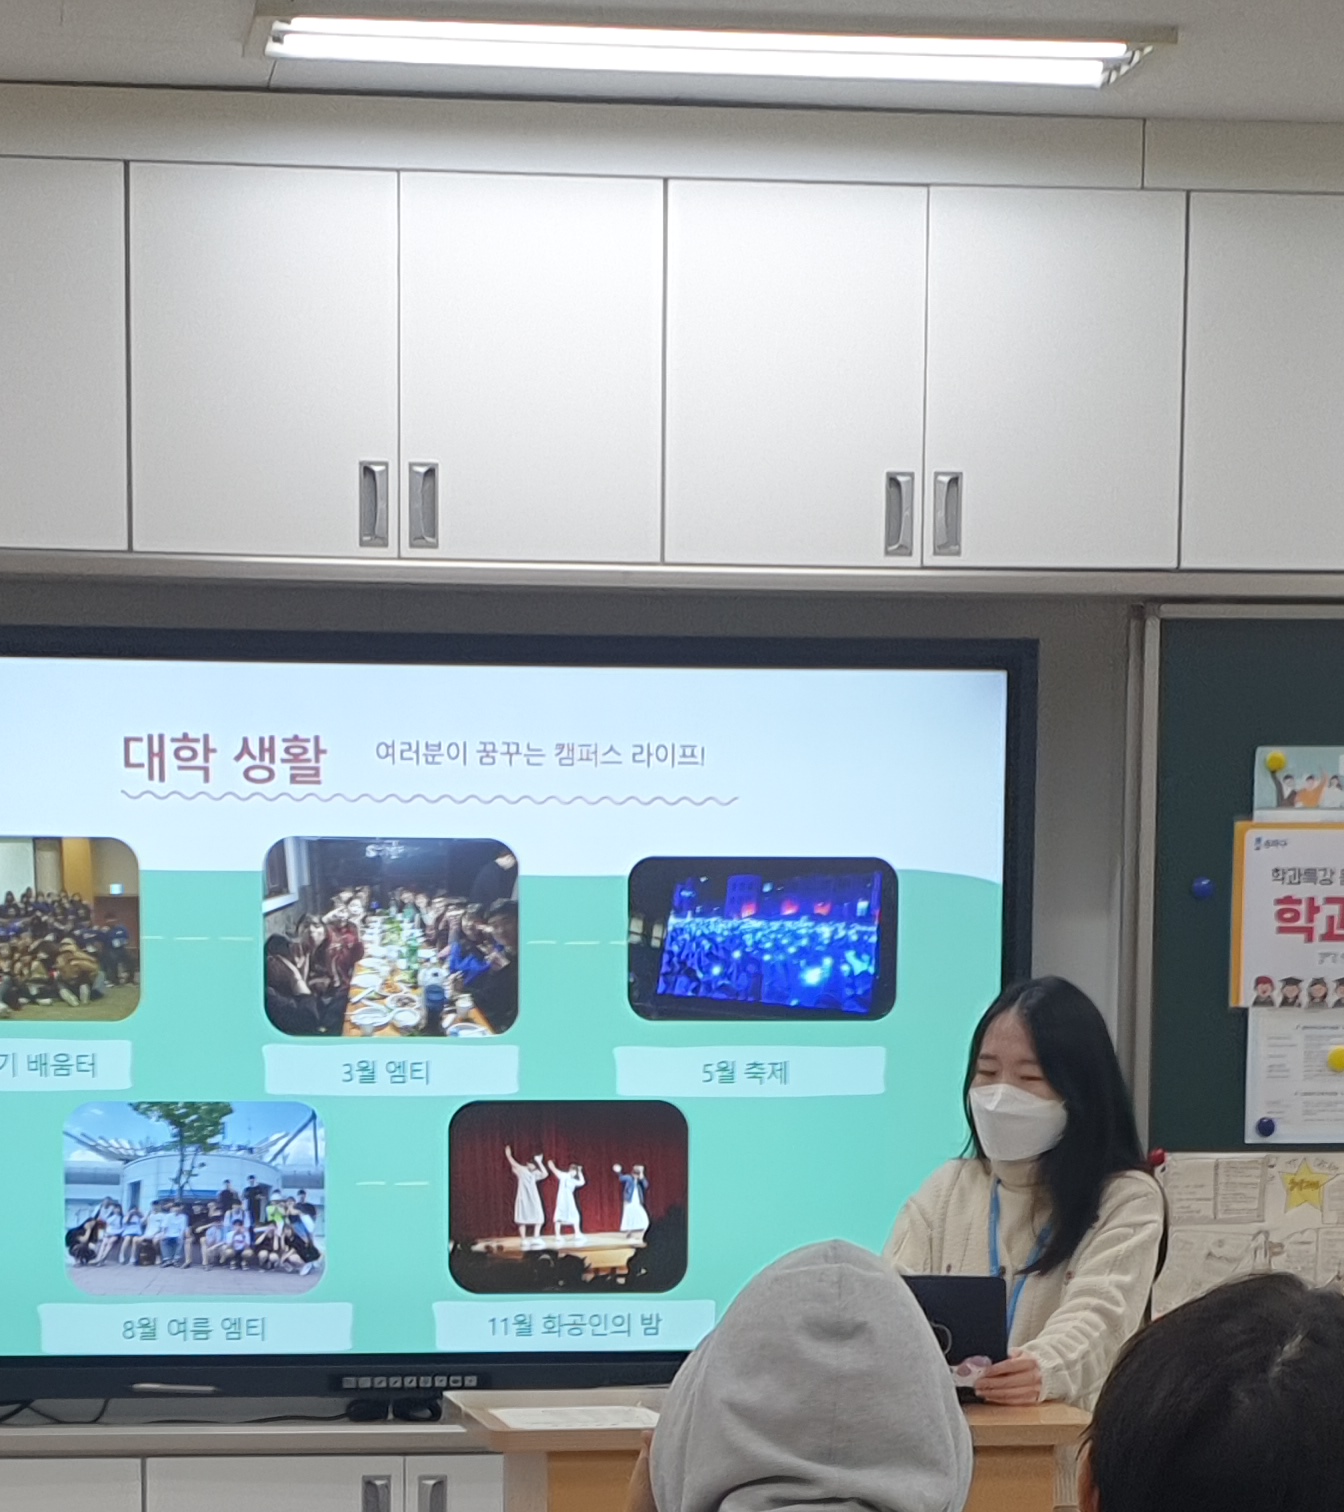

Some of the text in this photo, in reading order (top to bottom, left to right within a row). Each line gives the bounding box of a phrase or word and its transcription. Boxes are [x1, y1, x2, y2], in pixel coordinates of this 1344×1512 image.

[122, 732, 329, 786] 대학 생활
[375, 740, 707, 769] 여러분이 꿈꾸는 캠퍼스 라이프!
[1271, 866, 1335, 887] 학과특강
[26, 1051, 97, 1079] 배움터
[341, 1059, 431, 1086] 3월 엠티
[701, 1060, 790, 1087] 5월 축제
[121, 1316, 267, 1342] 8월 여름 엠티
[487, 1312, 663, 1339] 11월 화공인의 밤
